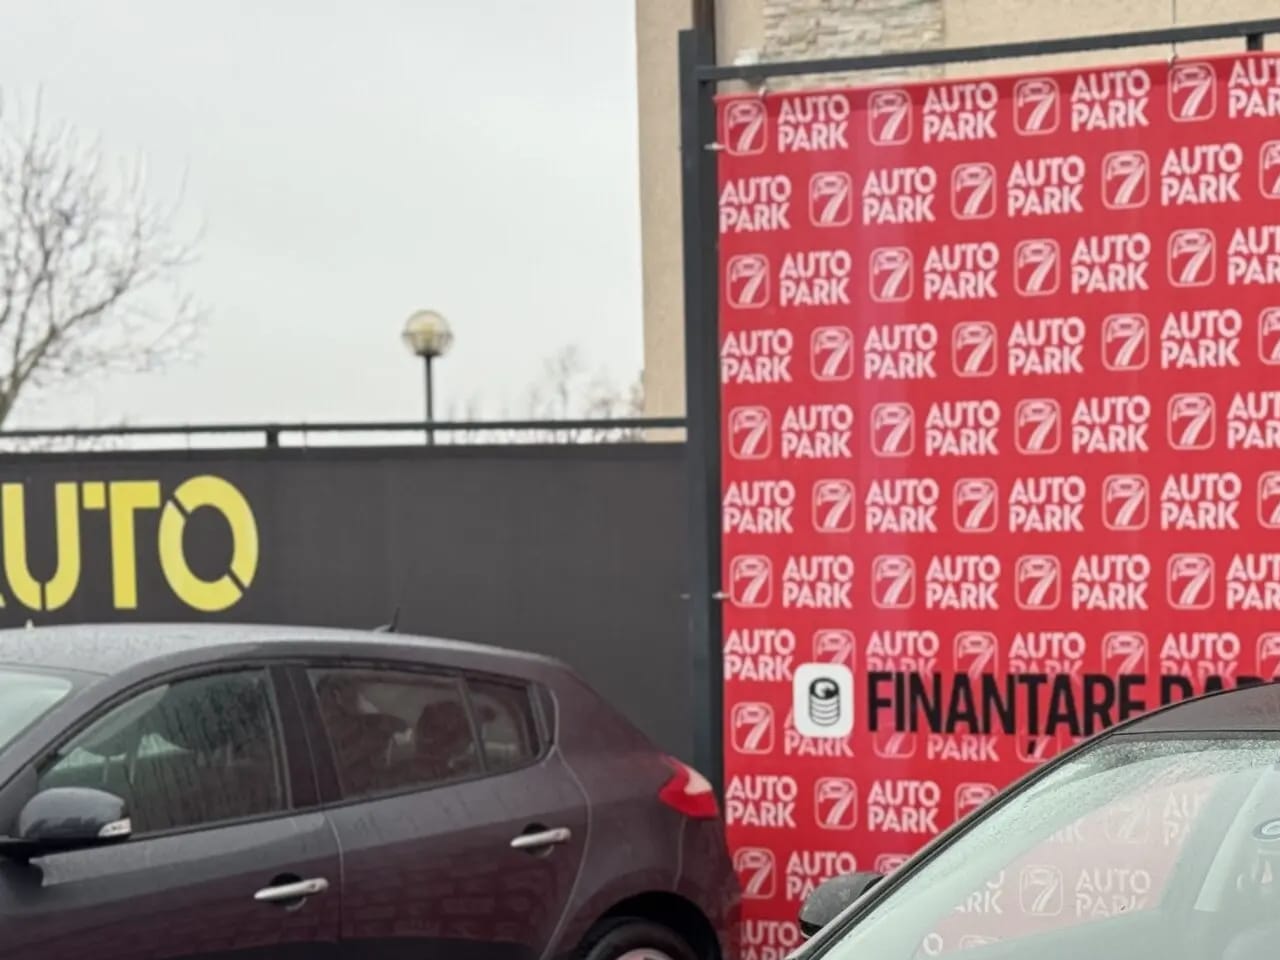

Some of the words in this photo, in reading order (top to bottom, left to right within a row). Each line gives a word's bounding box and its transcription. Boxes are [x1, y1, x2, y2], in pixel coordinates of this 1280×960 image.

[923, 83, 997, 114] AUTO
[1071, 69, 1150, 102] AUTO
[778, 95, 849, 125] AUTO
[1071, 98, 1148, 131] PARK
[778, 122, 847, 152] PARK
[923, 111, 995, 142] PARK
[1008, 156, 1085, 187] AUTO
[1161, 143, 1242, 175] AUTO
[719, 175, 791, 205] AUTO
[863, 166, 936, 196] AUTO
[1161, 173, 1240, 205] PARK
[863, 194, 934, 224] PARK
[1008, 185, 1083, 216] PARK
[719, 203, 789, 233] PARK
[924, 242, 999, 272] AUTO
[1072, 233, 1150, 264] AUTO
[780, 250, 851, 279] AUTO
[1072, 262, 1148, 293] PARK
[780, 277, 849, 306] PARK
[924, 270, 997, 300] PARK
[864, 323, 937, 351] AUTO
[1008, 317, 1085, 346] AUTO
[1161, 309, 1242, 339] AUTO
[721, 329, 793, 357] AUTO
[1161, 338, 1240, 368] PARK
[721, 356, 791, 384] PARK
[864, 351, 935, 379] PARK
[1008, 346, 1083, 375] PARK
[782, 404, 853, 431] AUTO
[926, 400, 1000, 428] AUTO
[1072, 396, 1150, 424] AUTO
[782, 431, 851, 458] PARK
[926, 428, 998, 456] PARK
[1072, 425, 1148, 453] PARK
[723, 480, 796, 506] AUTO
[866, 478, 939, 504] AUTO
[1009, 476, 1085, 503] AUTO
[1161, 472, 1241, 500] AUTO
[723, 508, 794, 534] PARK
[866, 506, 937, 532] PARK
[1009, 505, 1083, 532] PARK
[1161, 501, 1239, 529] PARK
[0, 475, 258, 611] UTO
[783, 556, 853, 581] AUTO
[926, 555, 1000, 581] AUTO
[1072, 555, 1150, 581] AUTO
[783, 583, 851, 608] PARK
[926, 583, 998, 609] PARK
[1072, 583, 1148, 609] PARK
[723, 629, 795, 656] AUTO
[866, 630, 939, 658] AUTO
[1009, 631, 1085, 660] AUTO
[1160, 632, 1240, 660] AUTO
[723, 655, 793, 683] PARK
[784, 735, 854, 759] PARK
[927, 734, 999, 762] PARK
[725, 775, 797, 801] AUTO
[867, 780, 941, 807] AUTO
[726, 800, 796, 828] PARK
[868, 804, 939, 833] PARK
[786, 851, 857, 876] AUTO
